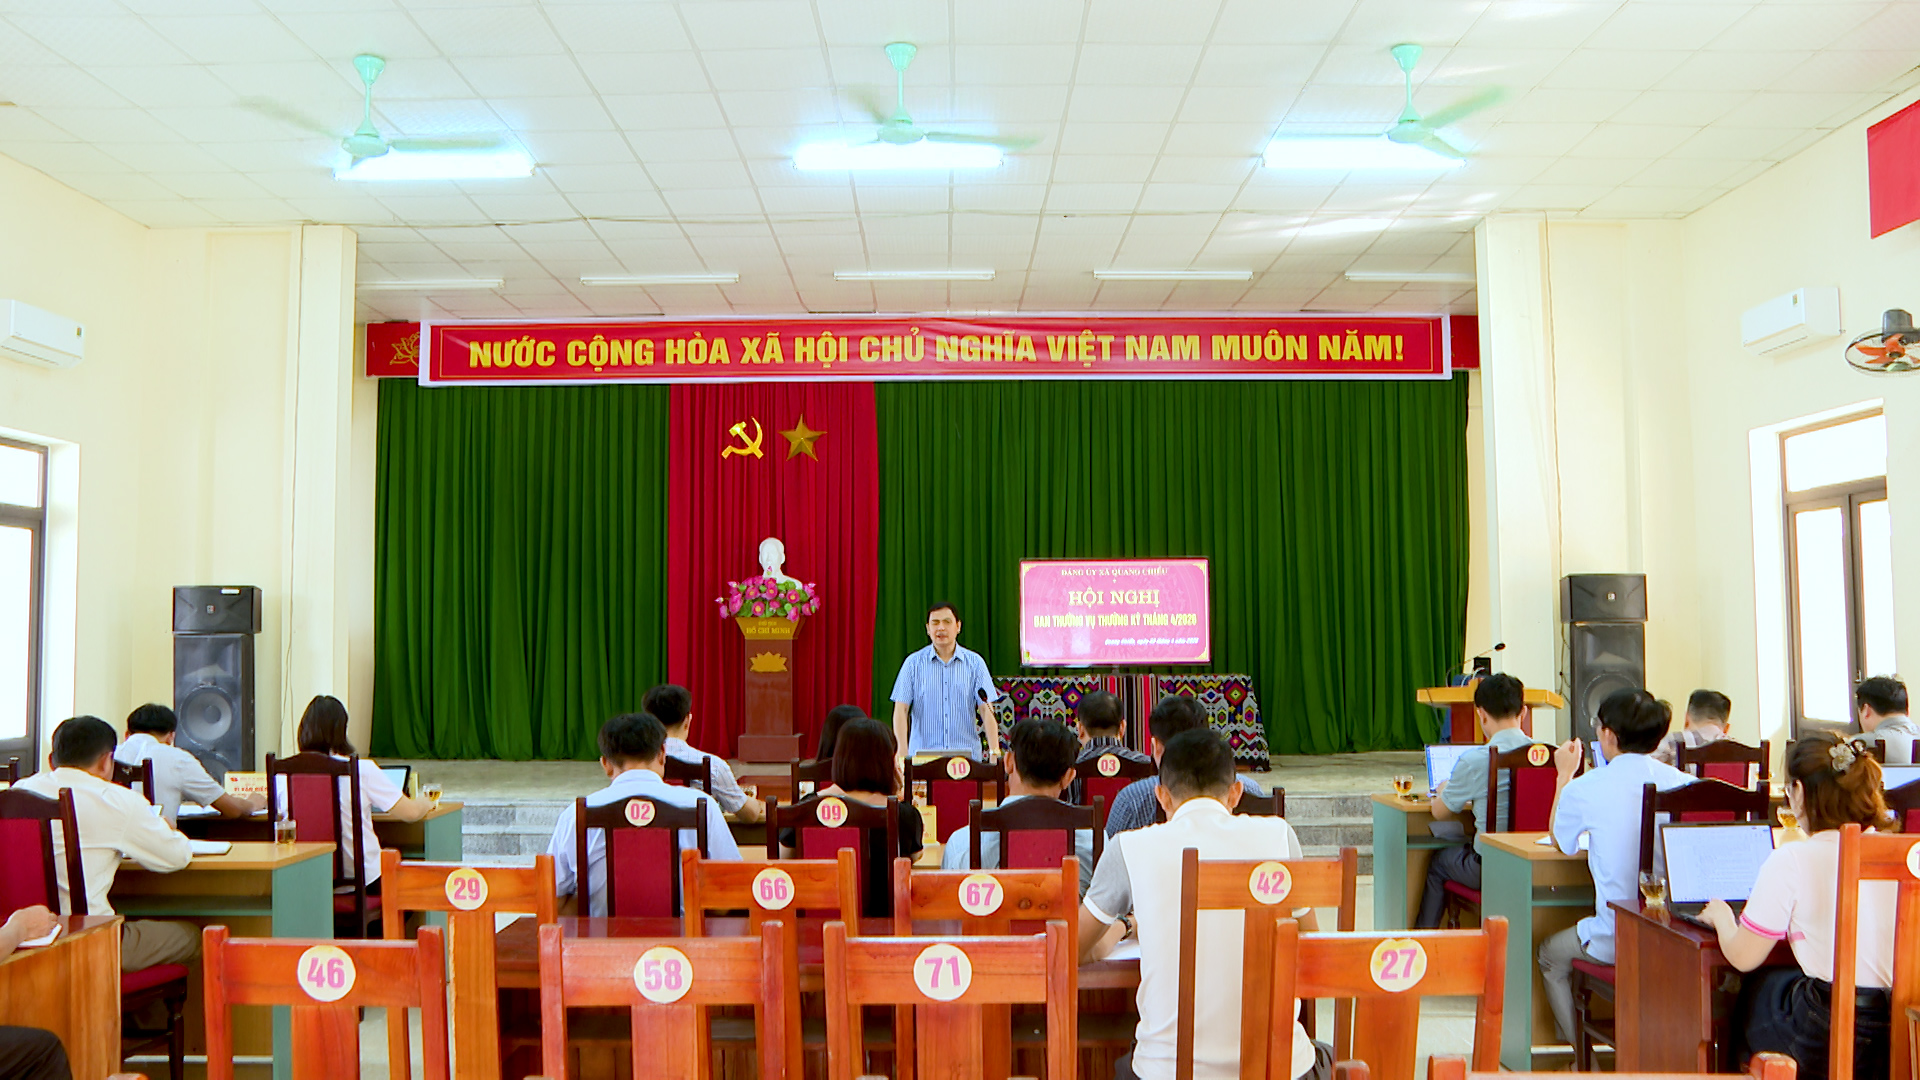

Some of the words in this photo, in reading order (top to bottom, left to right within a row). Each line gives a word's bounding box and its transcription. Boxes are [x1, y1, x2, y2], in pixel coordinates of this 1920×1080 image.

[470, 336, 556, 368] NƯỚC
[567, 334, 654, 372] CỘNG
[665, 331, 731, 365] HÒA
[740, 336, 785, 364] XÃ
[794, 331, 848, 369] HỘI
[859, 327, 926, 363] CHỦ
[935, 330, 1037, 363] NGHĨA
[1046, 329, 1116, 368] VIỆT
[1125, 335, 1201, 362] NAM
[1211, 329, 1308, 362] MUÔN
[1318, 328, 1404, 361] NĂM!
[1111, 568, 1141, 578] QUANG
[1068, 587, 1104, 608] HỘI
[1109, 589, 1160, 608] NGHỊ
[1033, 615, 1050, 628] BAN
[1085, 615, 1096, 630] VỤ
[1143, 611, 1169, 627] THÁNG
[1100, 759, 1117, 773] 03
[1531, 748, 1546, 762] 07
[951, 761, 967, 776] 10
[630, 803, 651, 821] 02
[821, 804, 842, 821] 09
[453, 877, 481, 901] 29
[759, 877, 788, 901] 66
[966, 883, 996, 907] 67
[1256, 871, 1286, 895] 42
[307, 957, 345, 989] 46
[643, 959, 683, 990] 58
[924, 956, 961, 988] 71
[1380, 949, 1418, 980] 27
